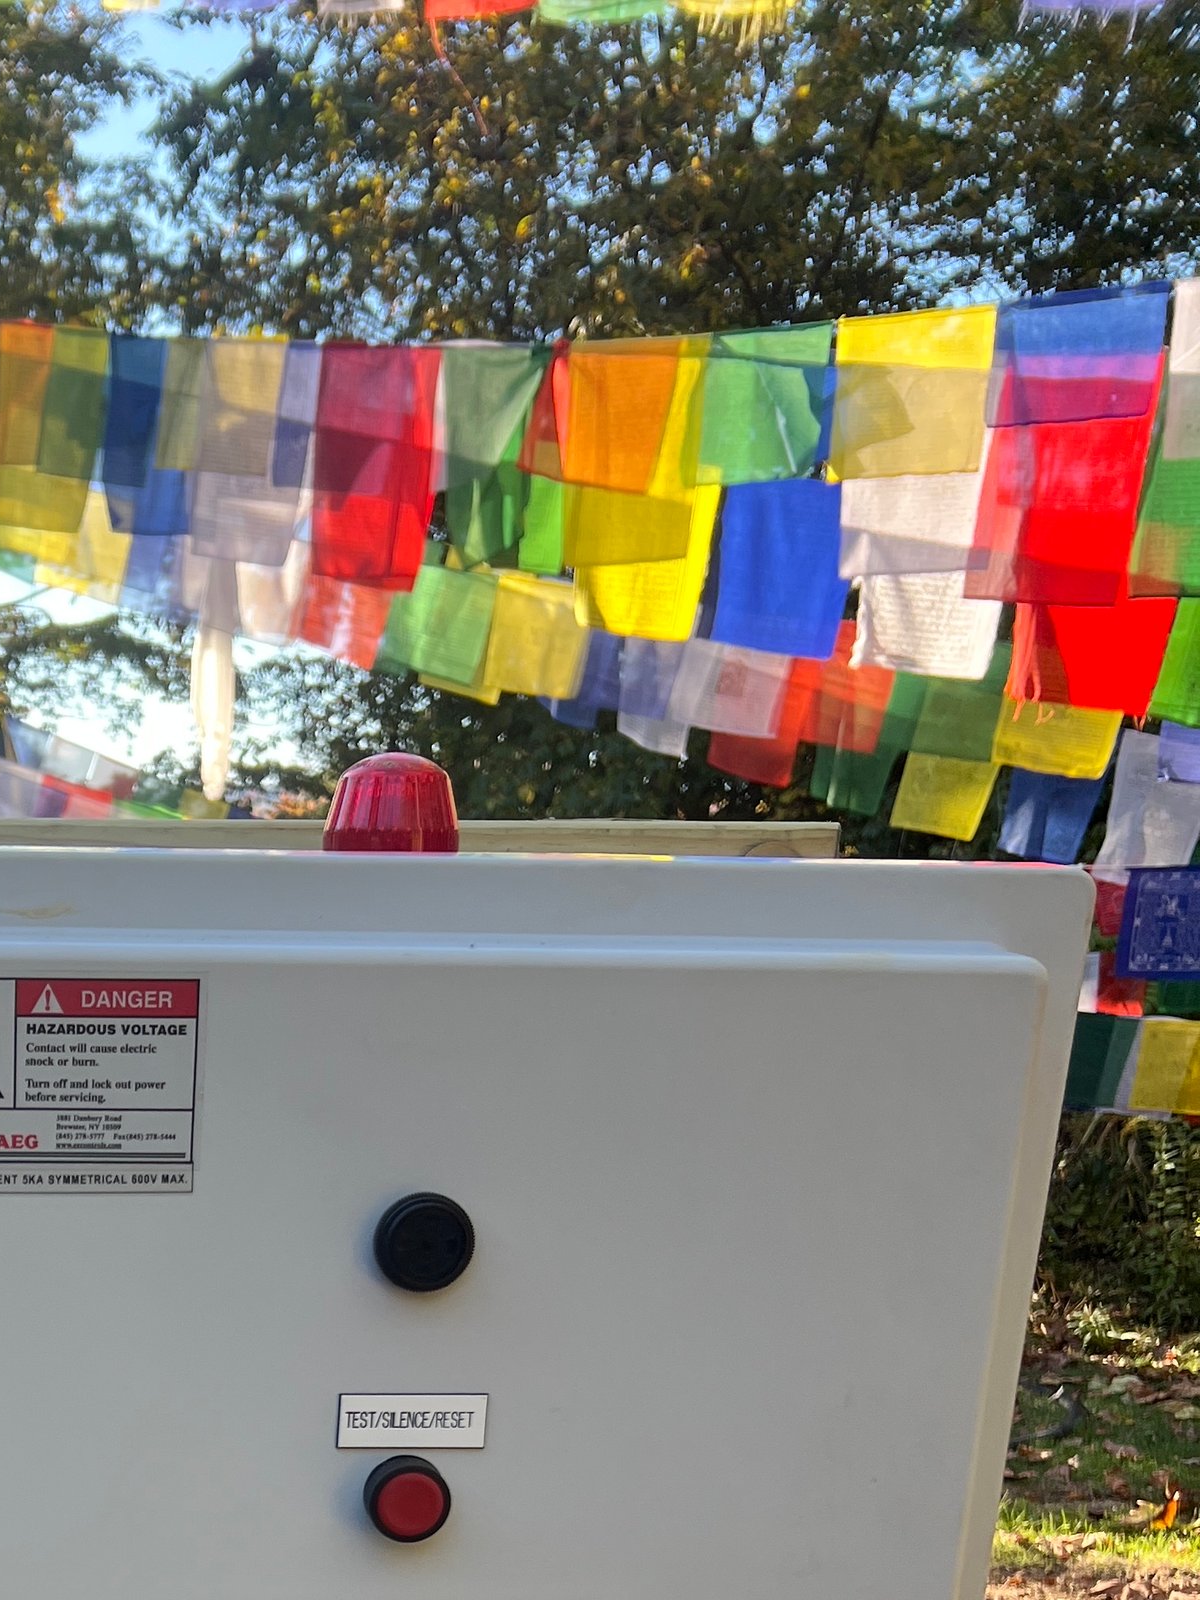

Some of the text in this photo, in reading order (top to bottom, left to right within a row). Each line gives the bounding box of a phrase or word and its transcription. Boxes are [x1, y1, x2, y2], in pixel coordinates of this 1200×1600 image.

[81, 990, 173, 1009] DANGER
[25, 1023, 188, 1036] HAZARDOUS VOLTAGE
[25, 1042, 157, 1055] Contact will cause electric
[25, 1056, 99, 1067] shock or burn.
[25, 1078, 166, 1094] Turn off and lock out power
[25, 1091, 106, 1105] before servicing.
[22, 1175, 43, 1185] 5KA
[48, 1174, 127, 1185] SYMMETRICAL
[132, 1174, 157, 1185] 600V
[161, 1174, 188, 1184] MAX.
[345, 1411, 475, 1429] TEST/SILENCE/RESET
